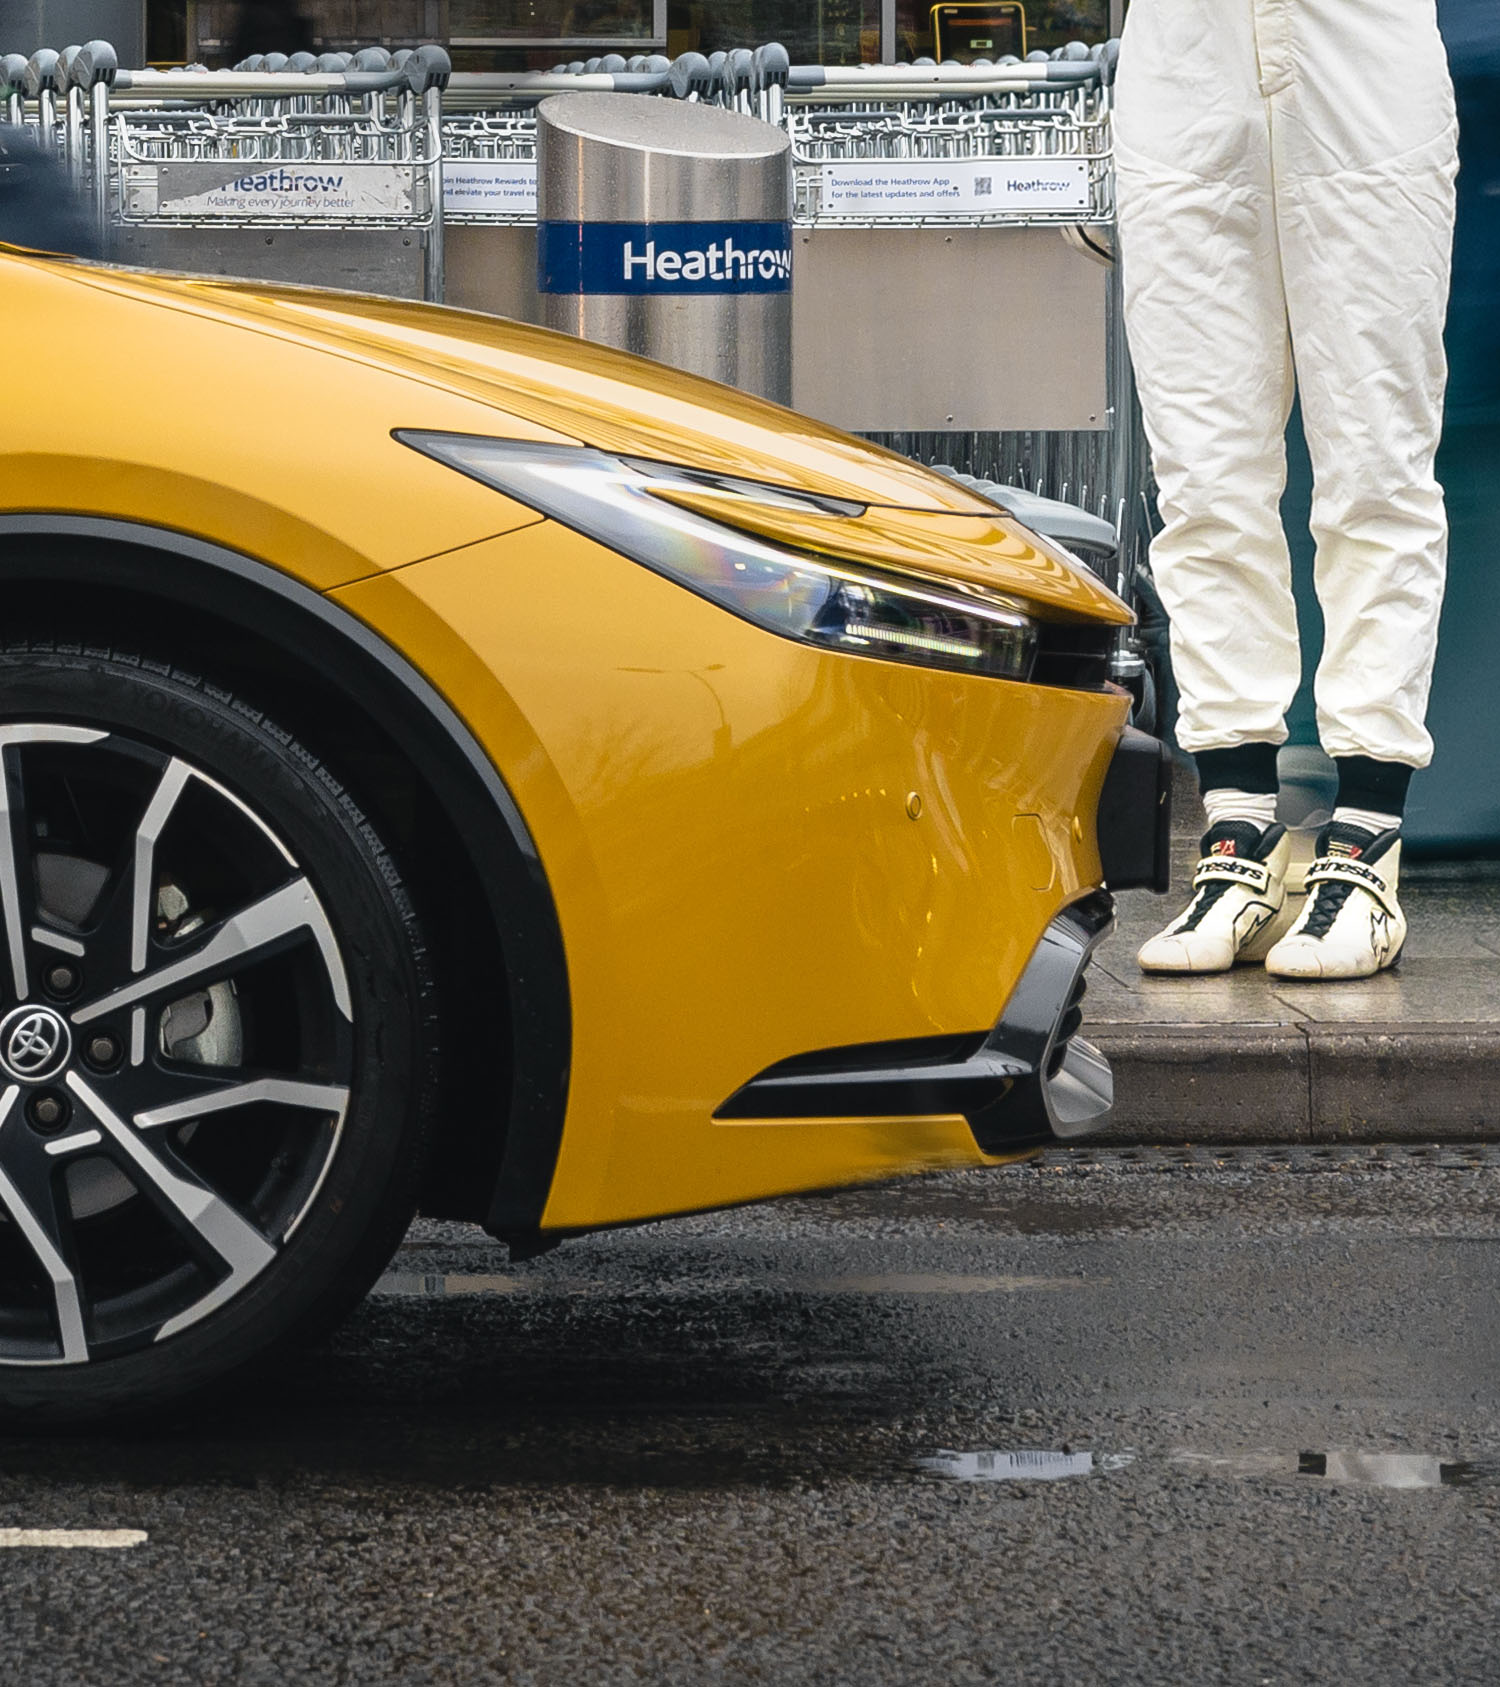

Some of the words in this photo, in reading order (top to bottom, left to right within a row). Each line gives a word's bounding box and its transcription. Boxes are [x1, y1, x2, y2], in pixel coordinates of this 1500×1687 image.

[456, 177, 494, 185] Heathrow
[495, 177, 528, 185] Rewards
[831, 178, 873, 187] Download
[875, 177, 889, 186] the
[891, 177, 931, 186] Heathrow
[933, 177, 950, 188] App
[1007, 178, 1070, 193] Heathrow
[503, 188, 525, 196] travel
[831, 190, 846, 199] for
[847, 189, 860, 199] the
[861, 189, 884, 199] latest
[885, 189, 918, 201] updates
[919, 188, 935, 198] and
[937, 188, 960, 198] offers
[206, 196, 246, 210] Making
[248, 198, 278, 211] every
[279, 197, 321, 211] journey
[322, 196, 356, 209] better
[623, 237, 792, 281] Heathrow
